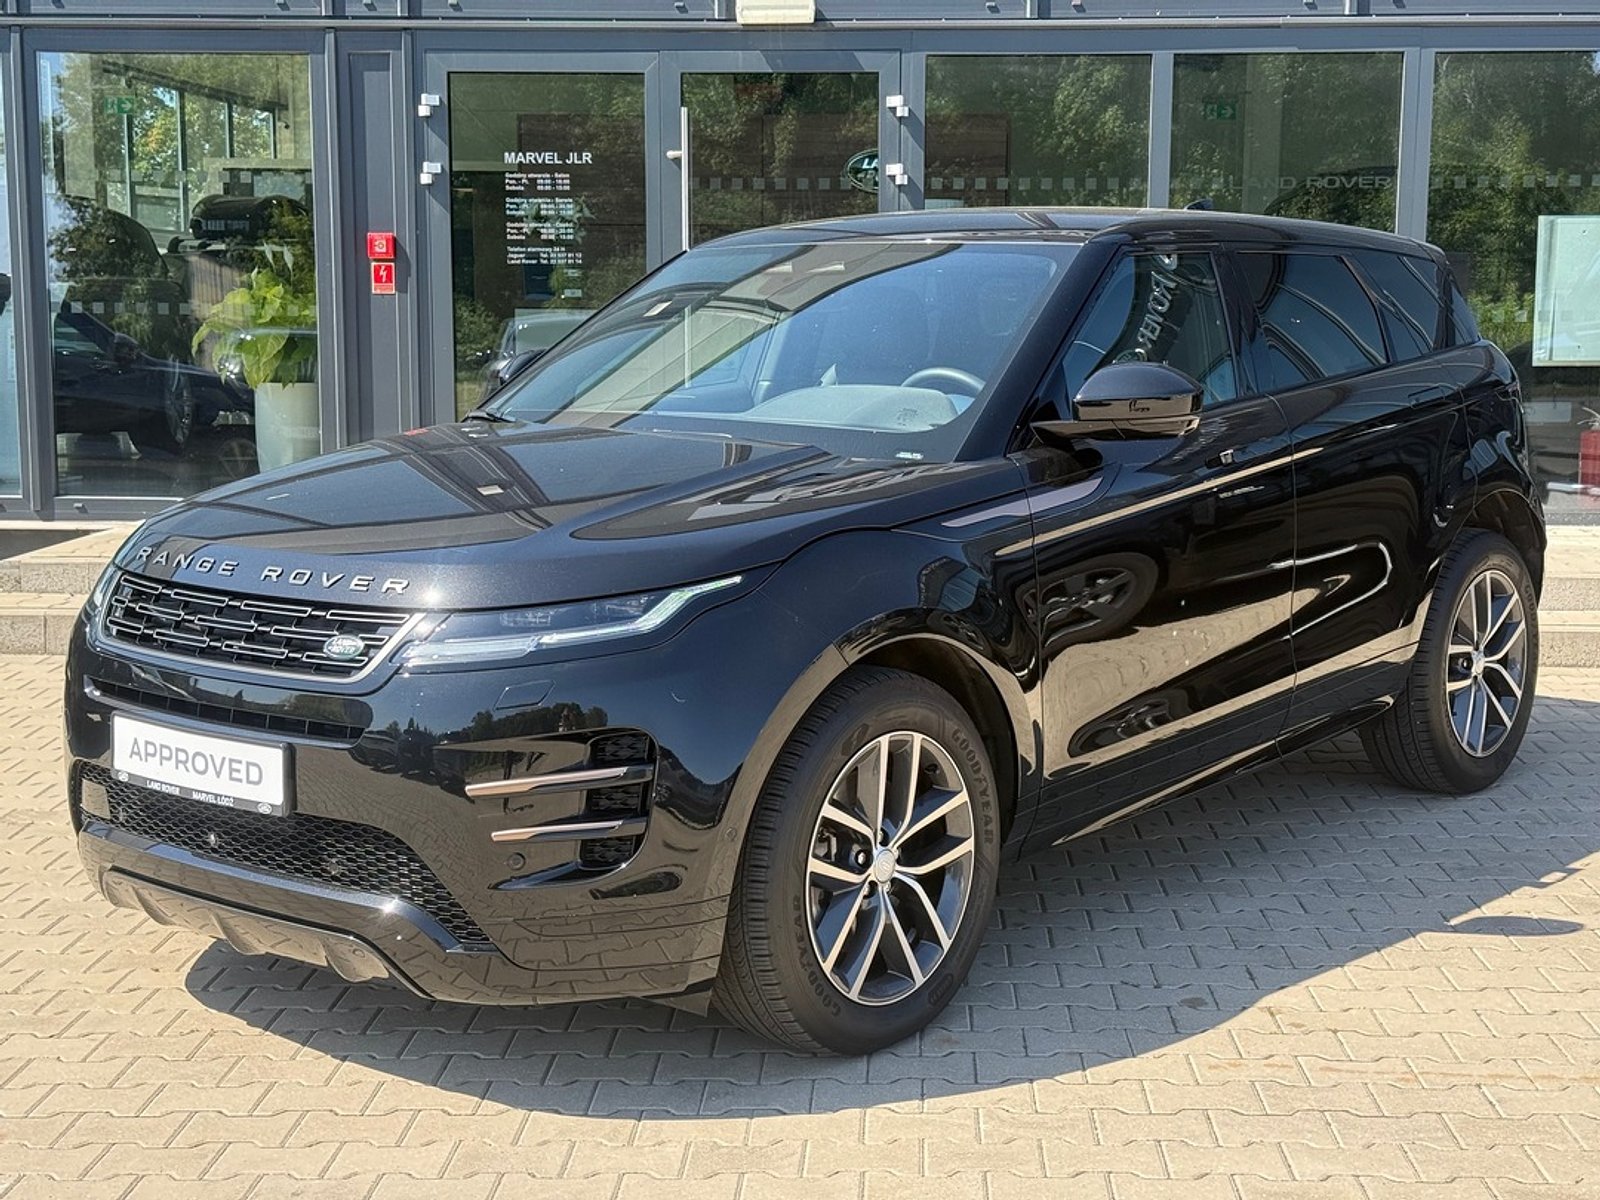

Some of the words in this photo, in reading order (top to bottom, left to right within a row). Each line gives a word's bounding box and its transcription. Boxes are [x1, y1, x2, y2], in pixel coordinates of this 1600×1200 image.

[503, 152, 563, 164] MARVEL
[565, 152, 593, 164] JLR
[1306, 175, 1391, 189] ROVER
[135, 546, 240, 577] RANGE
[260, 566, 410, 595] ROVER
[129, 737, 264, 787] APPROVED
[952, 727, 994, 845] GOODYEAR
